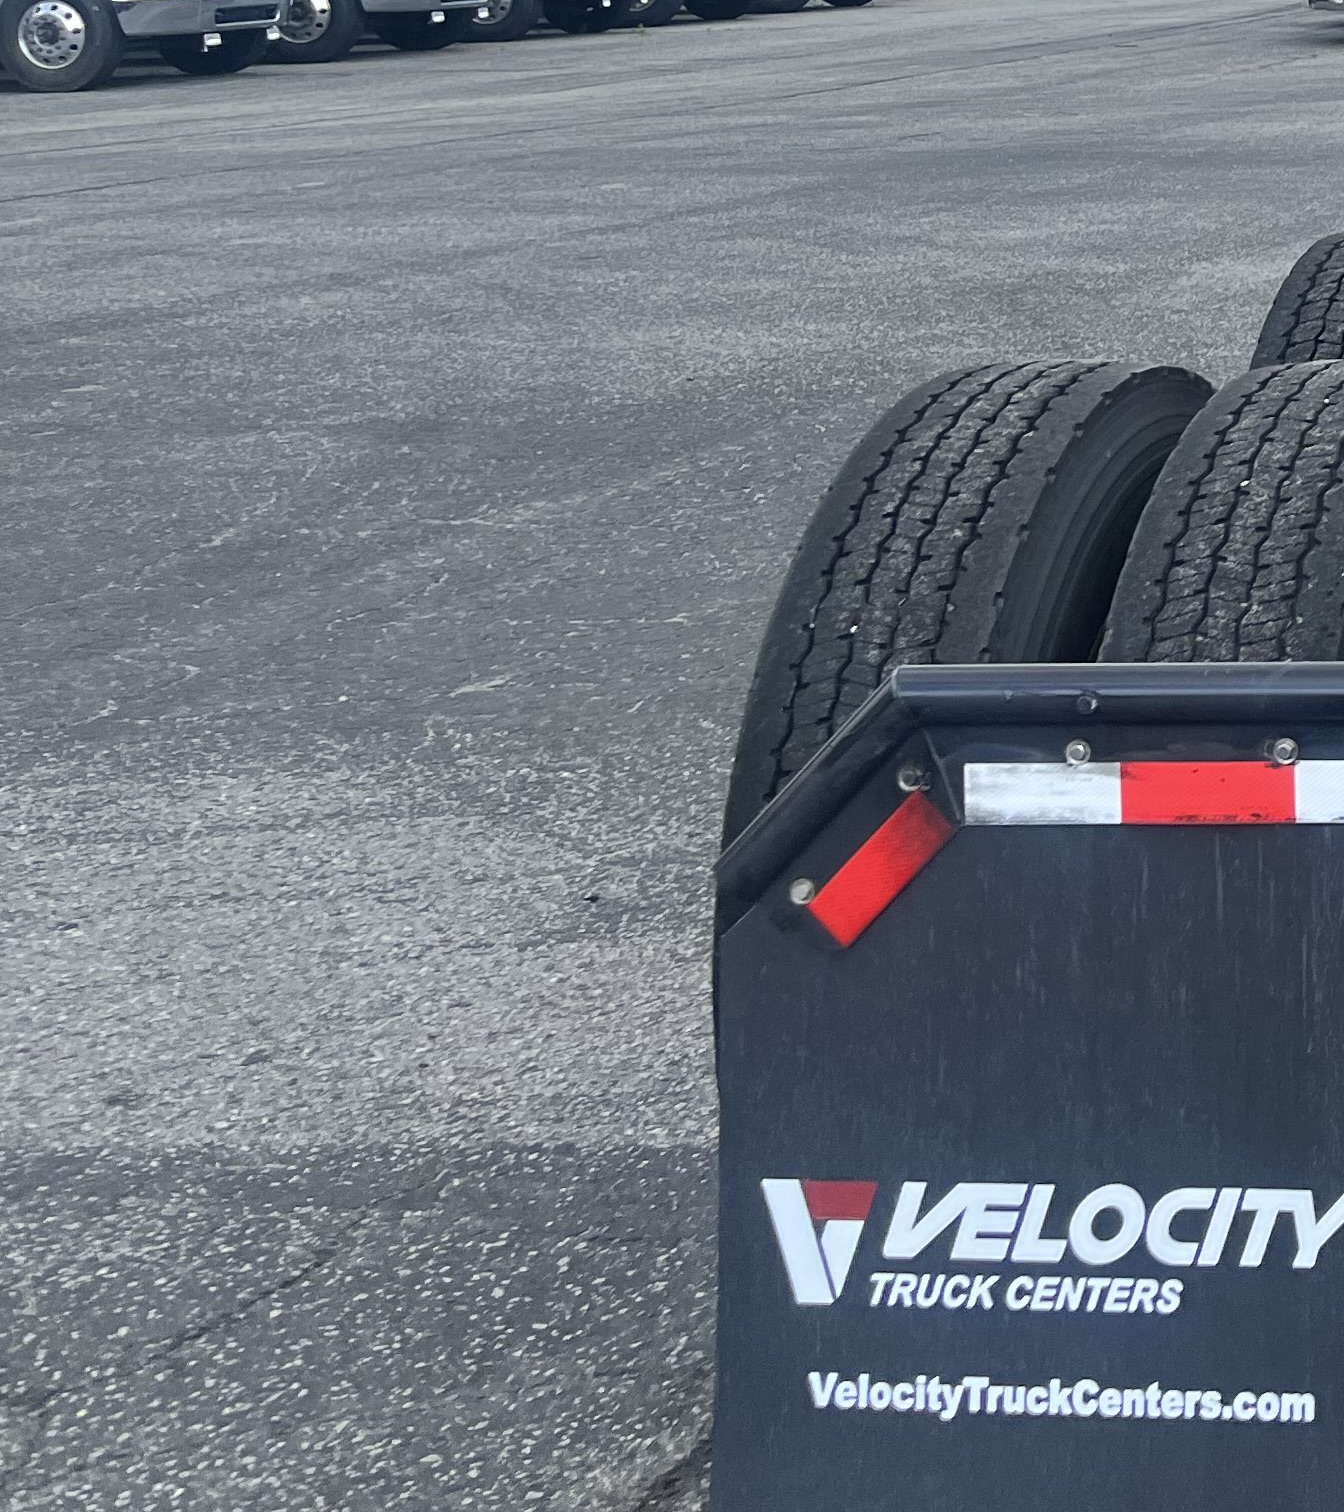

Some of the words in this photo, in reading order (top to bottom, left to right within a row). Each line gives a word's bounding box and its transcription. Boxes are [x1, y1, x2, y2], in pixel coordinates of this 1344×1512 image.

[869, 1272, 1000, 1308] TRUCK
[1005, 1276, 1184, 1315] CENTERS
[807, 1371, 1316, 1423] VelocityTruckCenters.com
